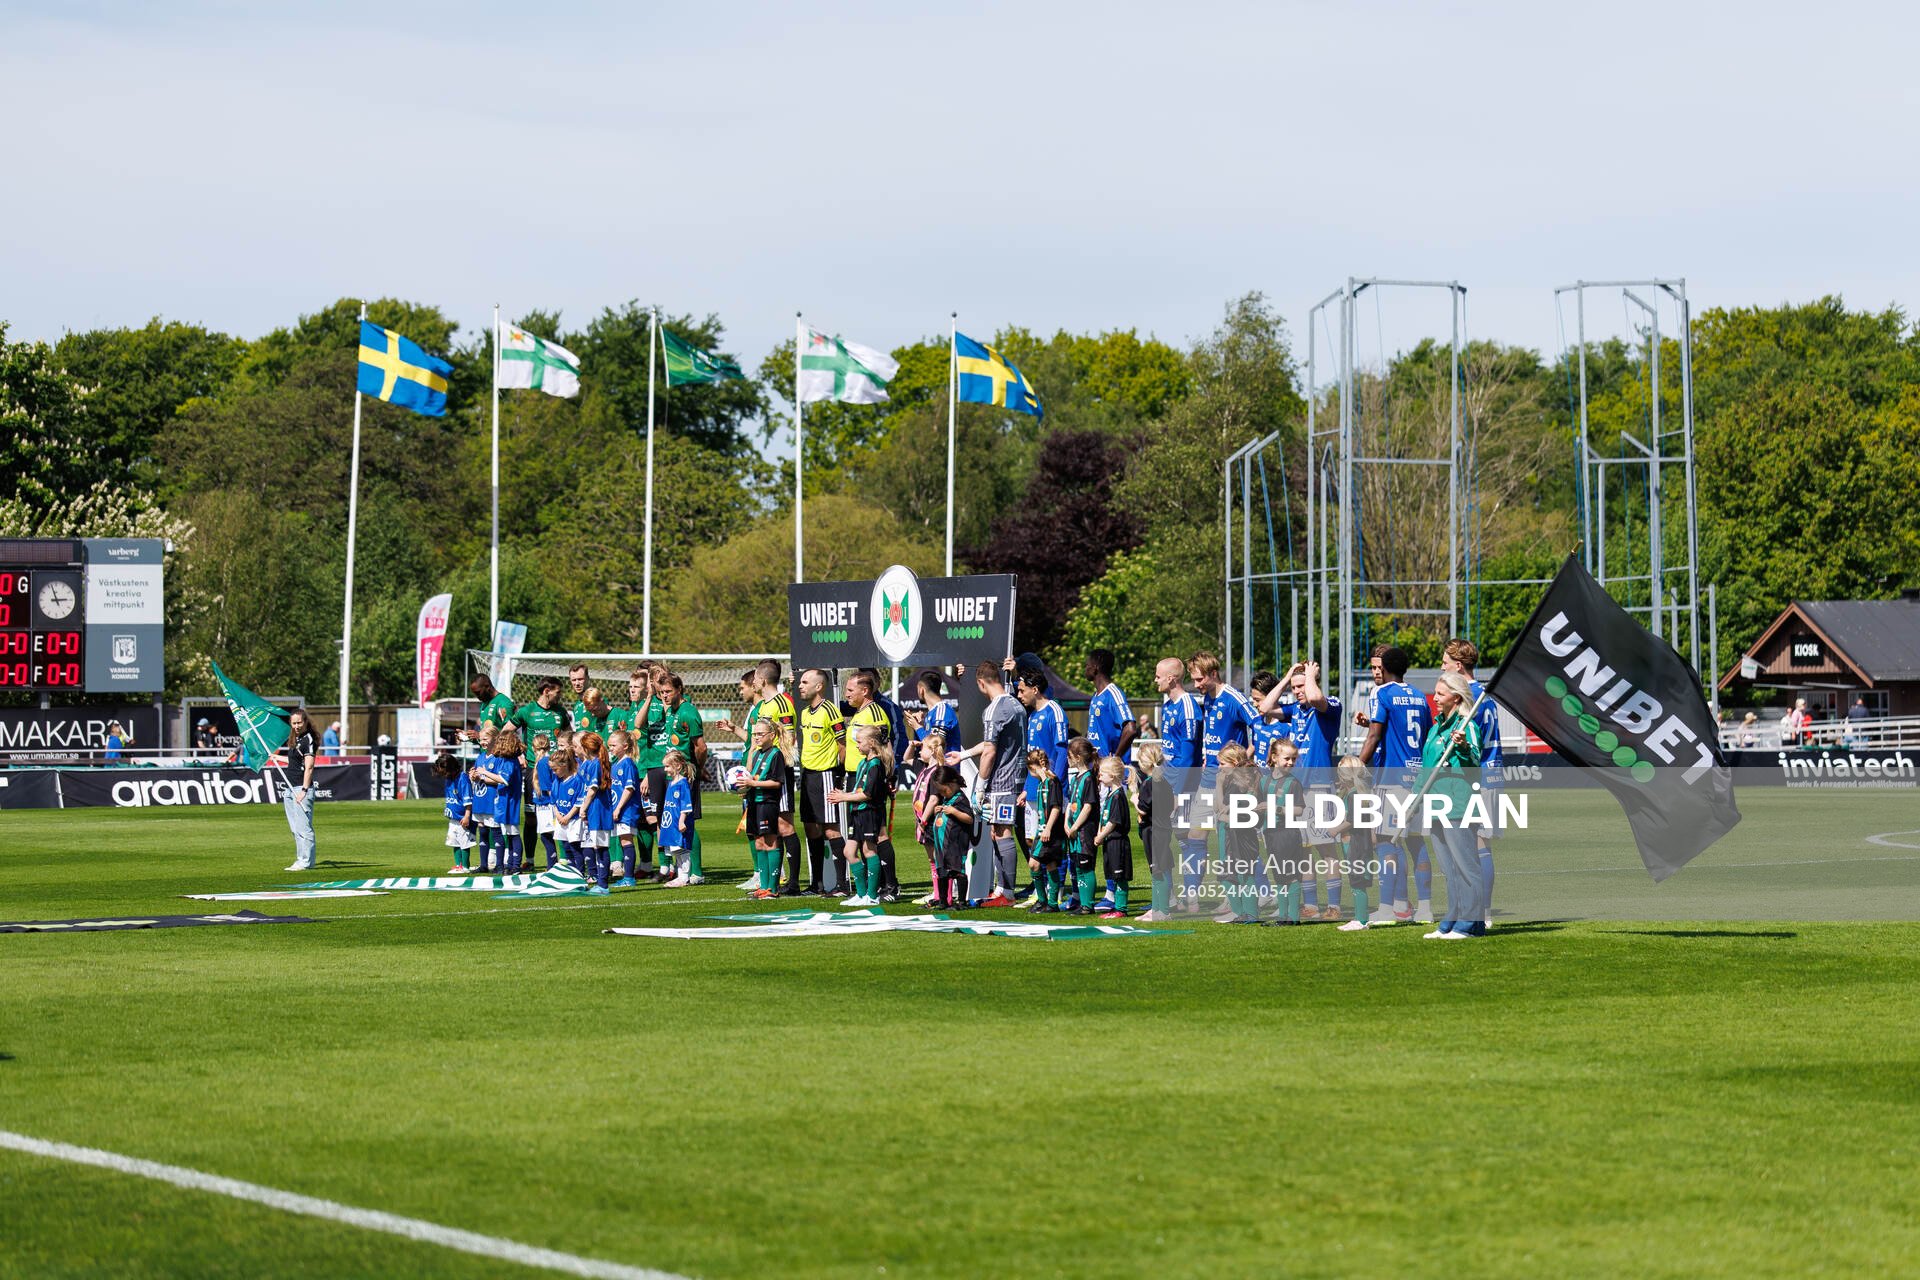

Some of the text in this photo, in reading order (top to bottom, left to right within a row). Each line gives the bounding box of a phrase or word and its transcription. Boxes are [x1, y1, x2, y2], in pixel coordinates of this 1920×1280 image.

[18, 576, 29, 594] G
[98, 578, 150, 589] Västkustens
[106, 589, 142, 599] kreativa
[103, 600, 145, 611] mittpunkt
[800, 601, 858, 627] UNIBET
[935, 596, 998, 622] UNIBET
[34, 632, 80, 655] E 0-0
[1794, 643, 1819, 657] KIOSK
[34, 663, 80, 686] F 0-0
[1407, 709, 1421, 749] 5
[1778, 751, 1916, 778] inviatech
[112, 772, 264, 808] granitor
